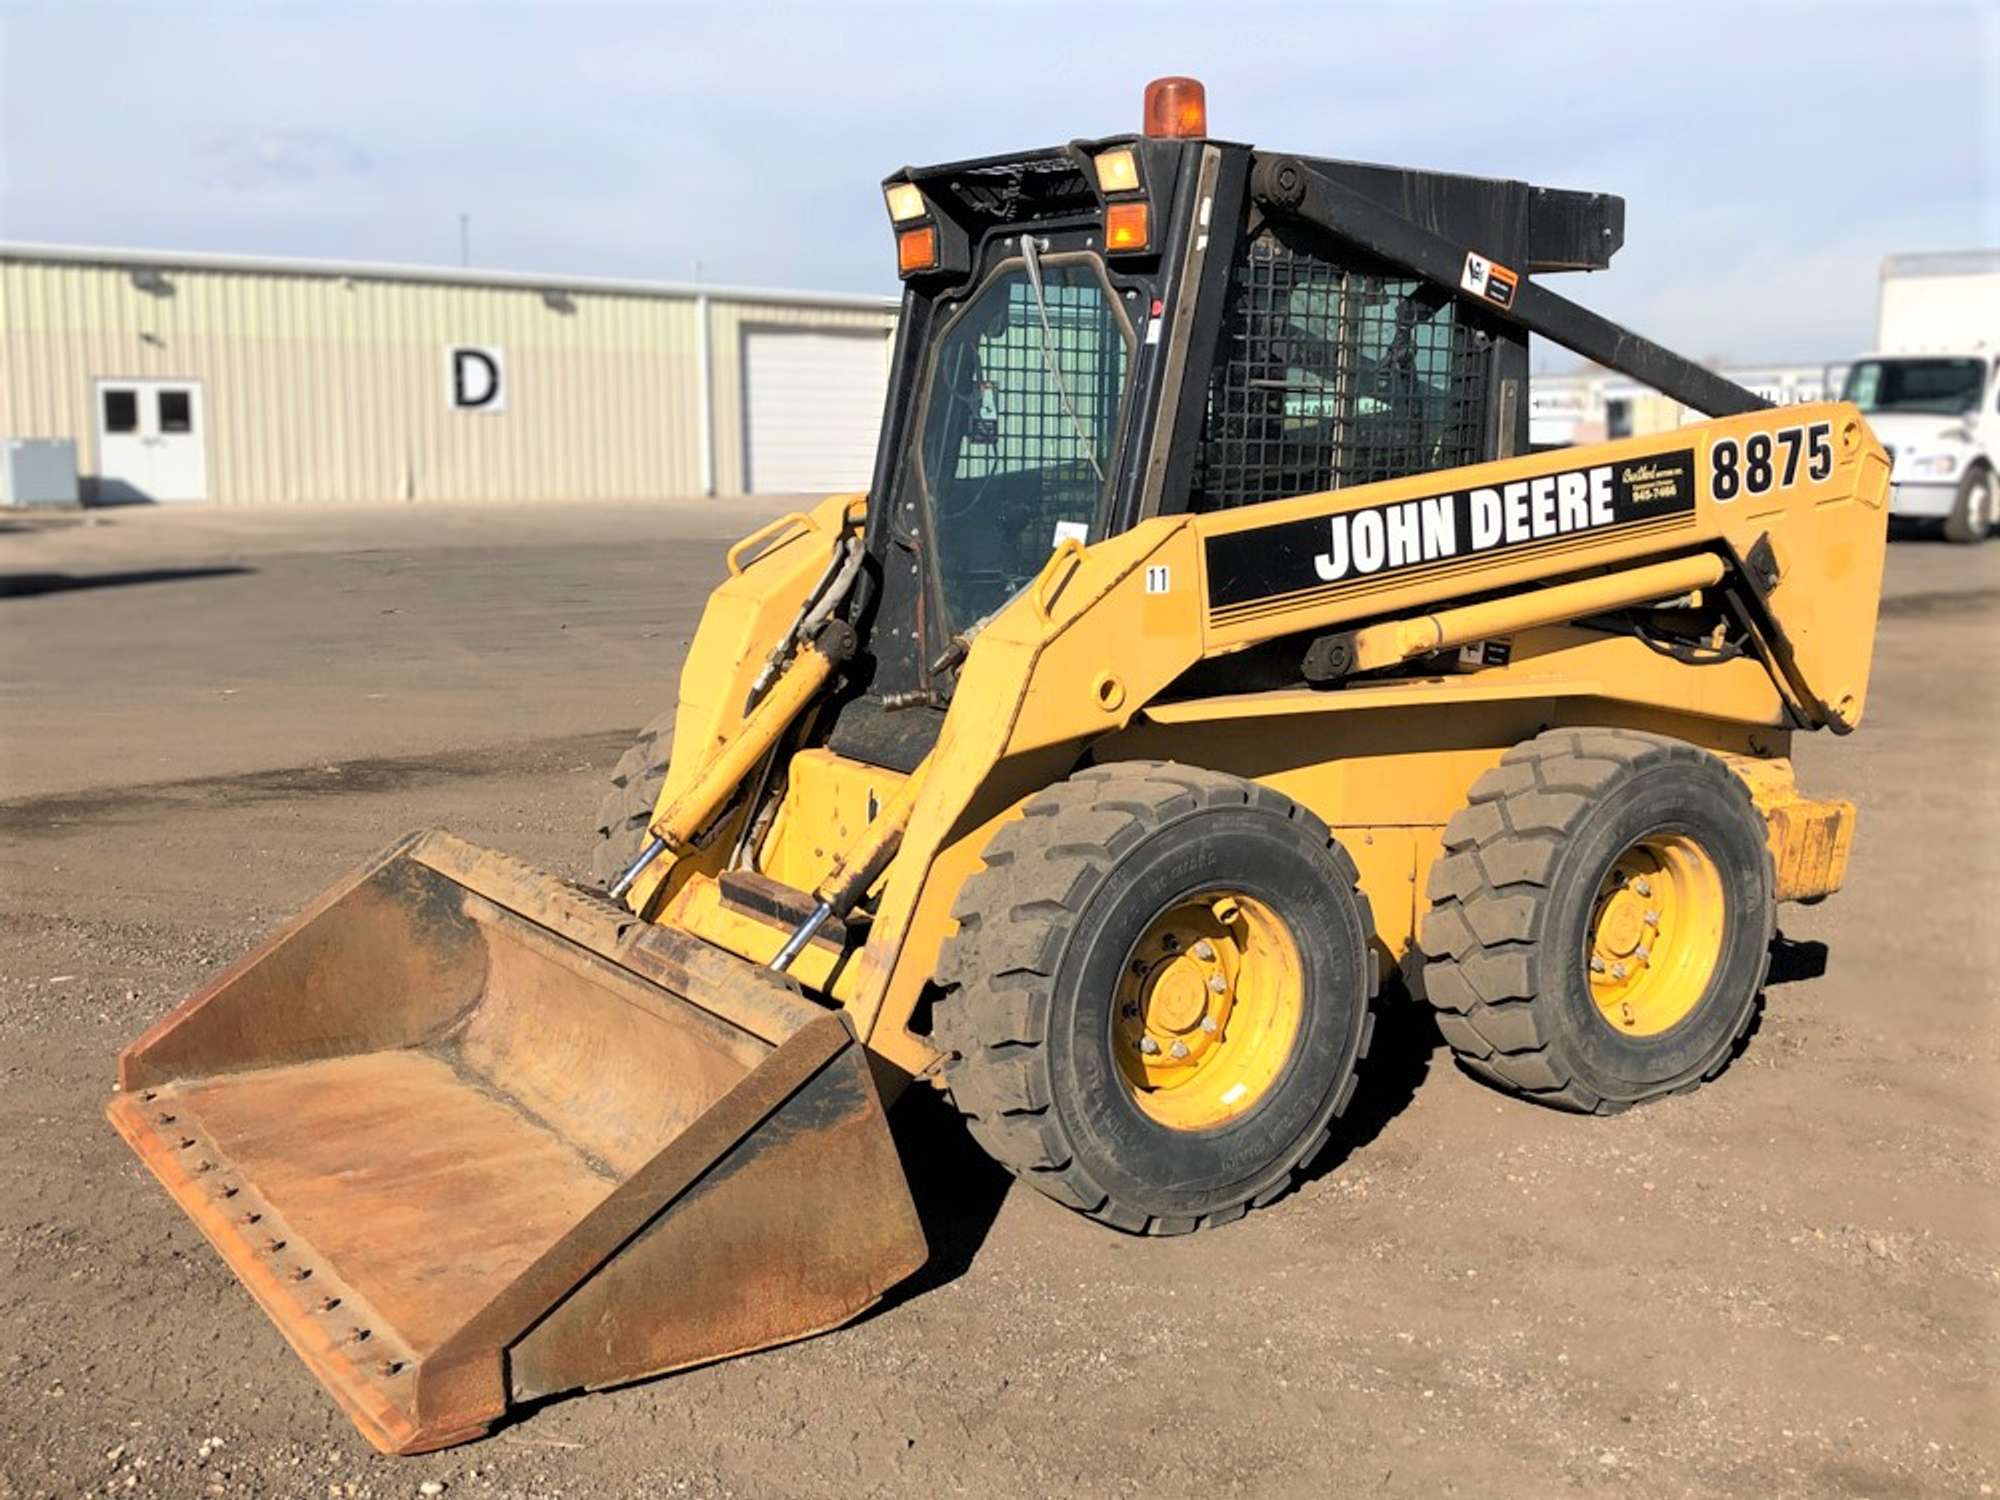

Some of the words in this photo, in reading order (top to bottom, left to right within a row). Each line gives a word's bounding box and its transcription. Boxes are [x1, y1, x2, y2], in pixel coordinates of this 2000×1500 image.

[453, 350, 499, 407] D
[1711, 422, 1832, 502] 8875
[1314, 491, 1456, 581] JOHN
[1470, 467, 1614, 552] DEERE
[1149, 567, 1167, 592] 11
